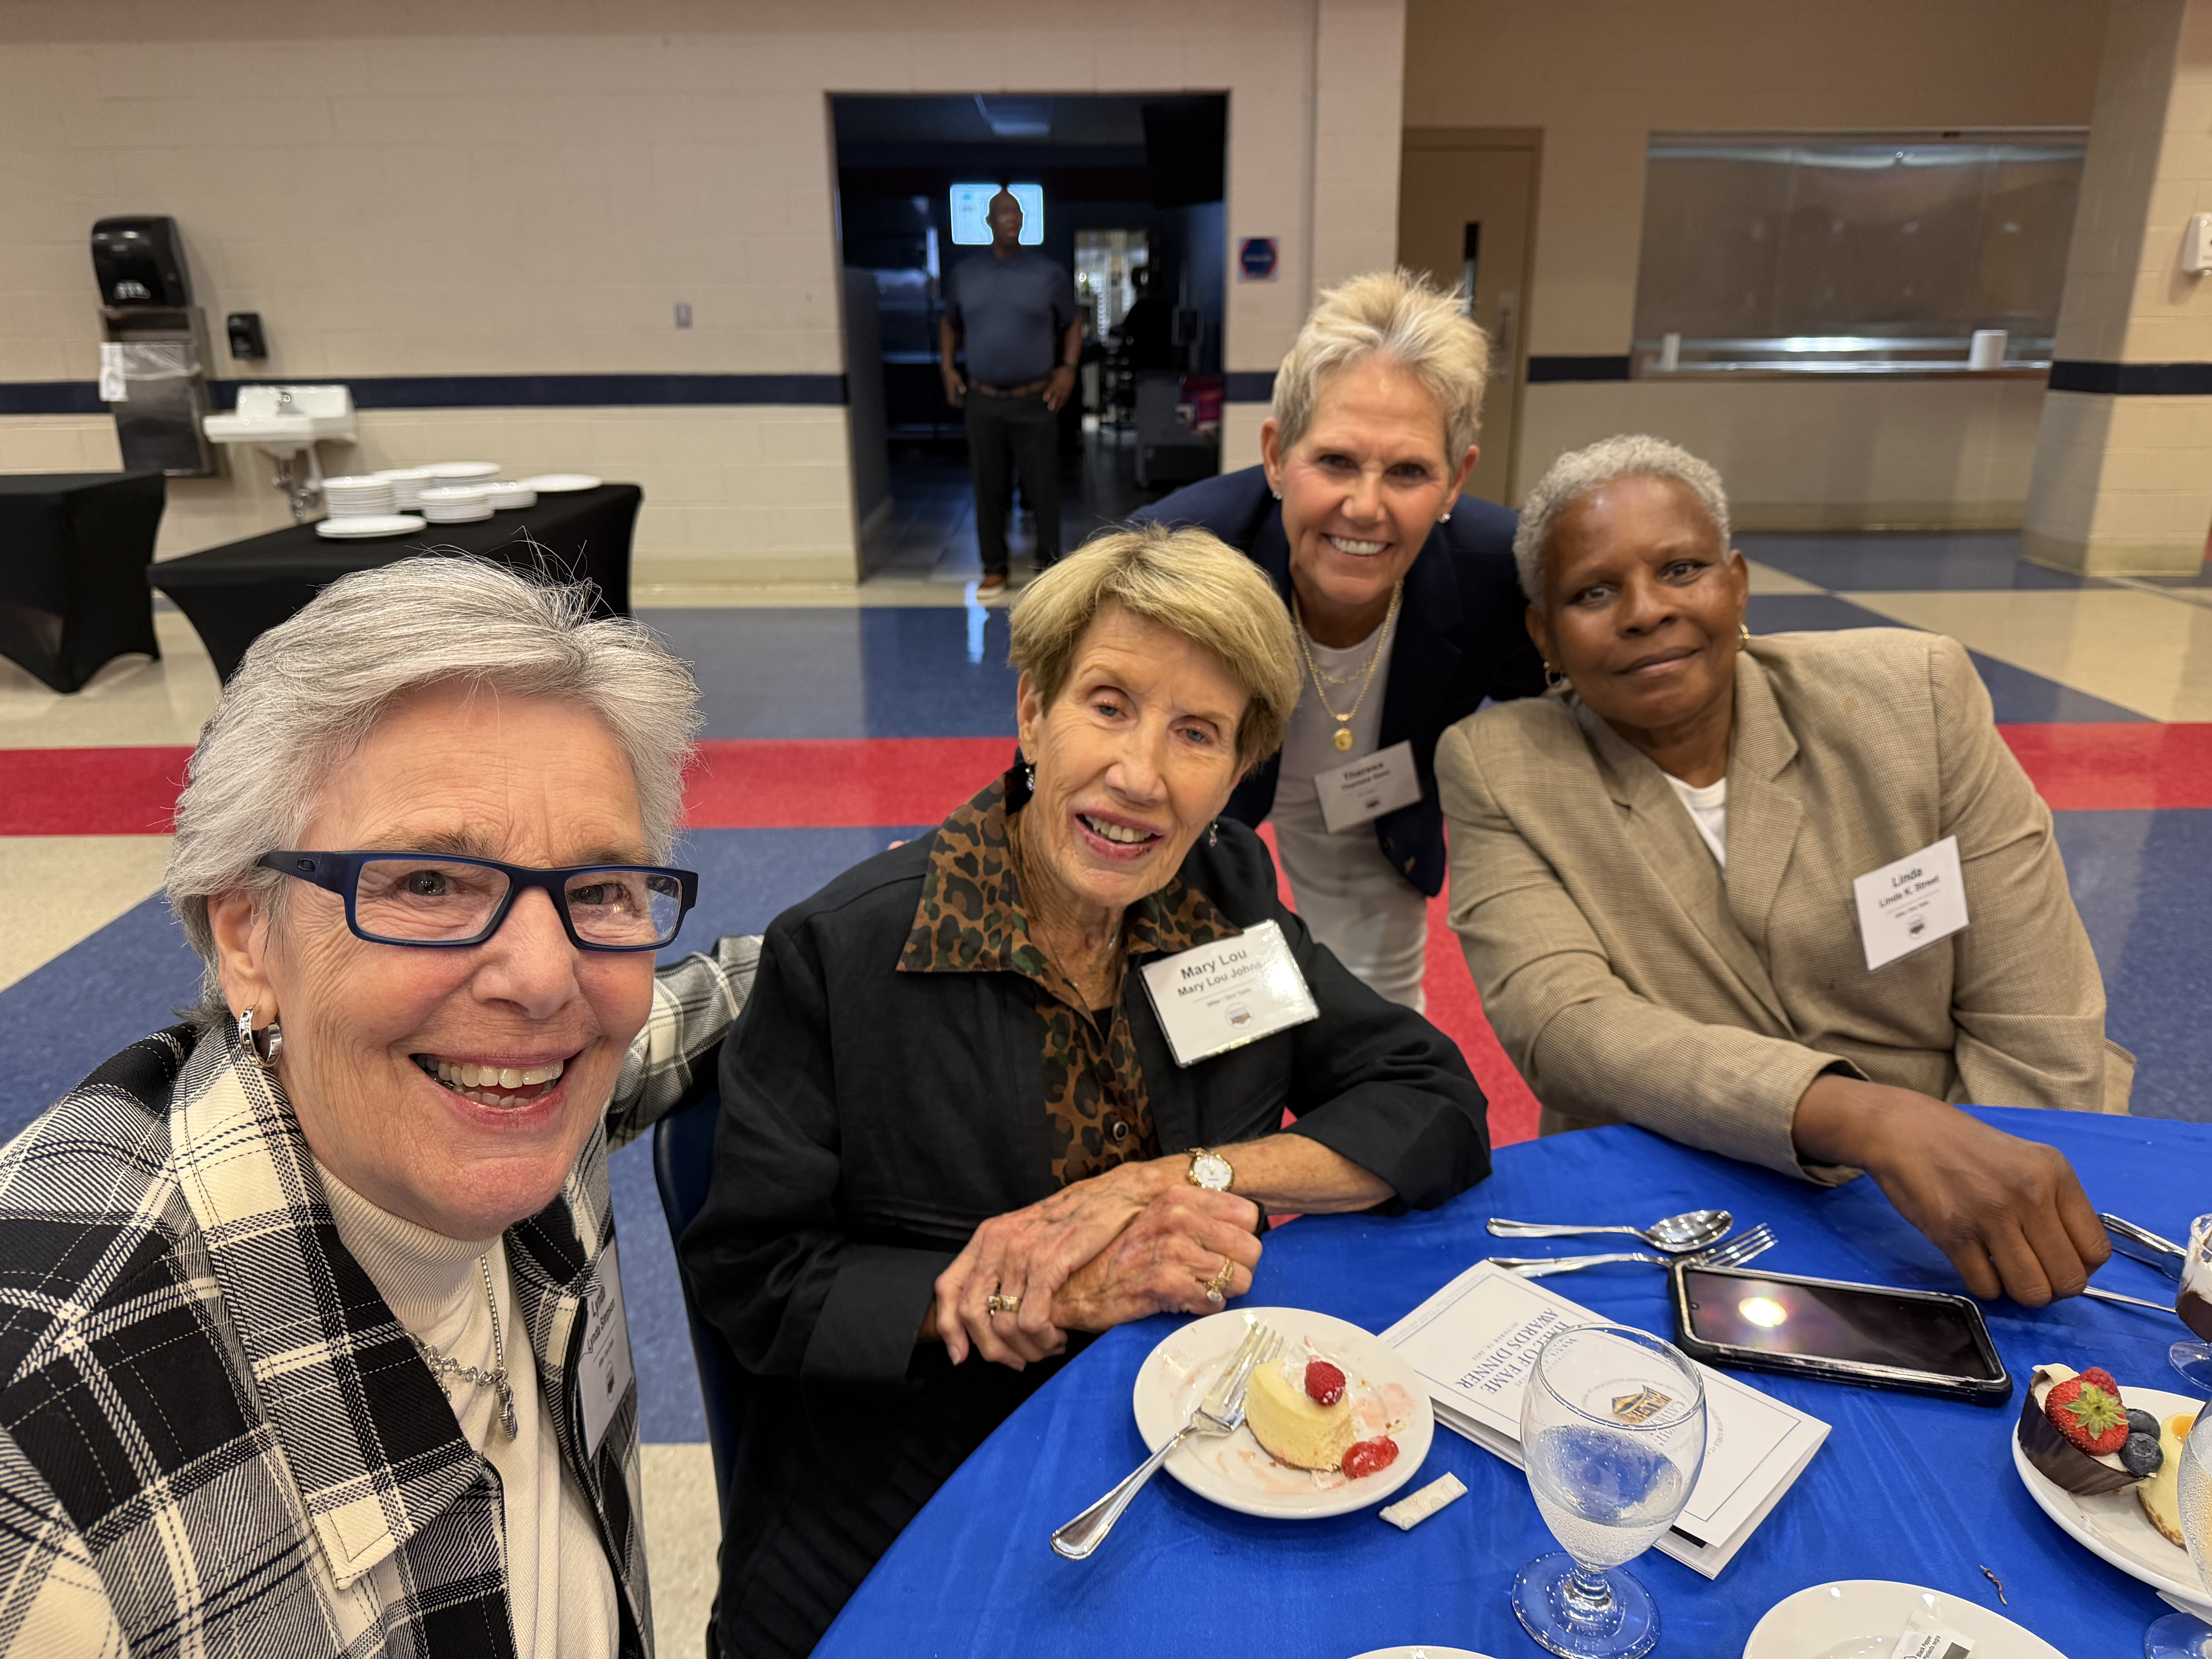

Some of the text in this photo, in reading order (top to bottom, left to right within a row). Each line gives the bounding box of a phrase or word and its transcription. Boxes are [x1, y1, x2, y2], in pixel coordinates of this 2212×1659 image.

[1891, 867, 1923, 888] Linda
[1180, 949, 1247, 979] Mary Lou
[1178, 981, 1204, 997] Mary
[1207, 974, 1228, 987] Lou
[1506, 1307, 1558, 1350] AWARDS
[1455, 1348, 1513, 1388] DINNER
[1518, 1349, 1539, 1366] OF
[1480, 1364, 1523, 1394] FAME
[1916, 1635, 1932, 1657] Black Pepper
[1932, 1635, 1941, 1646] negra
